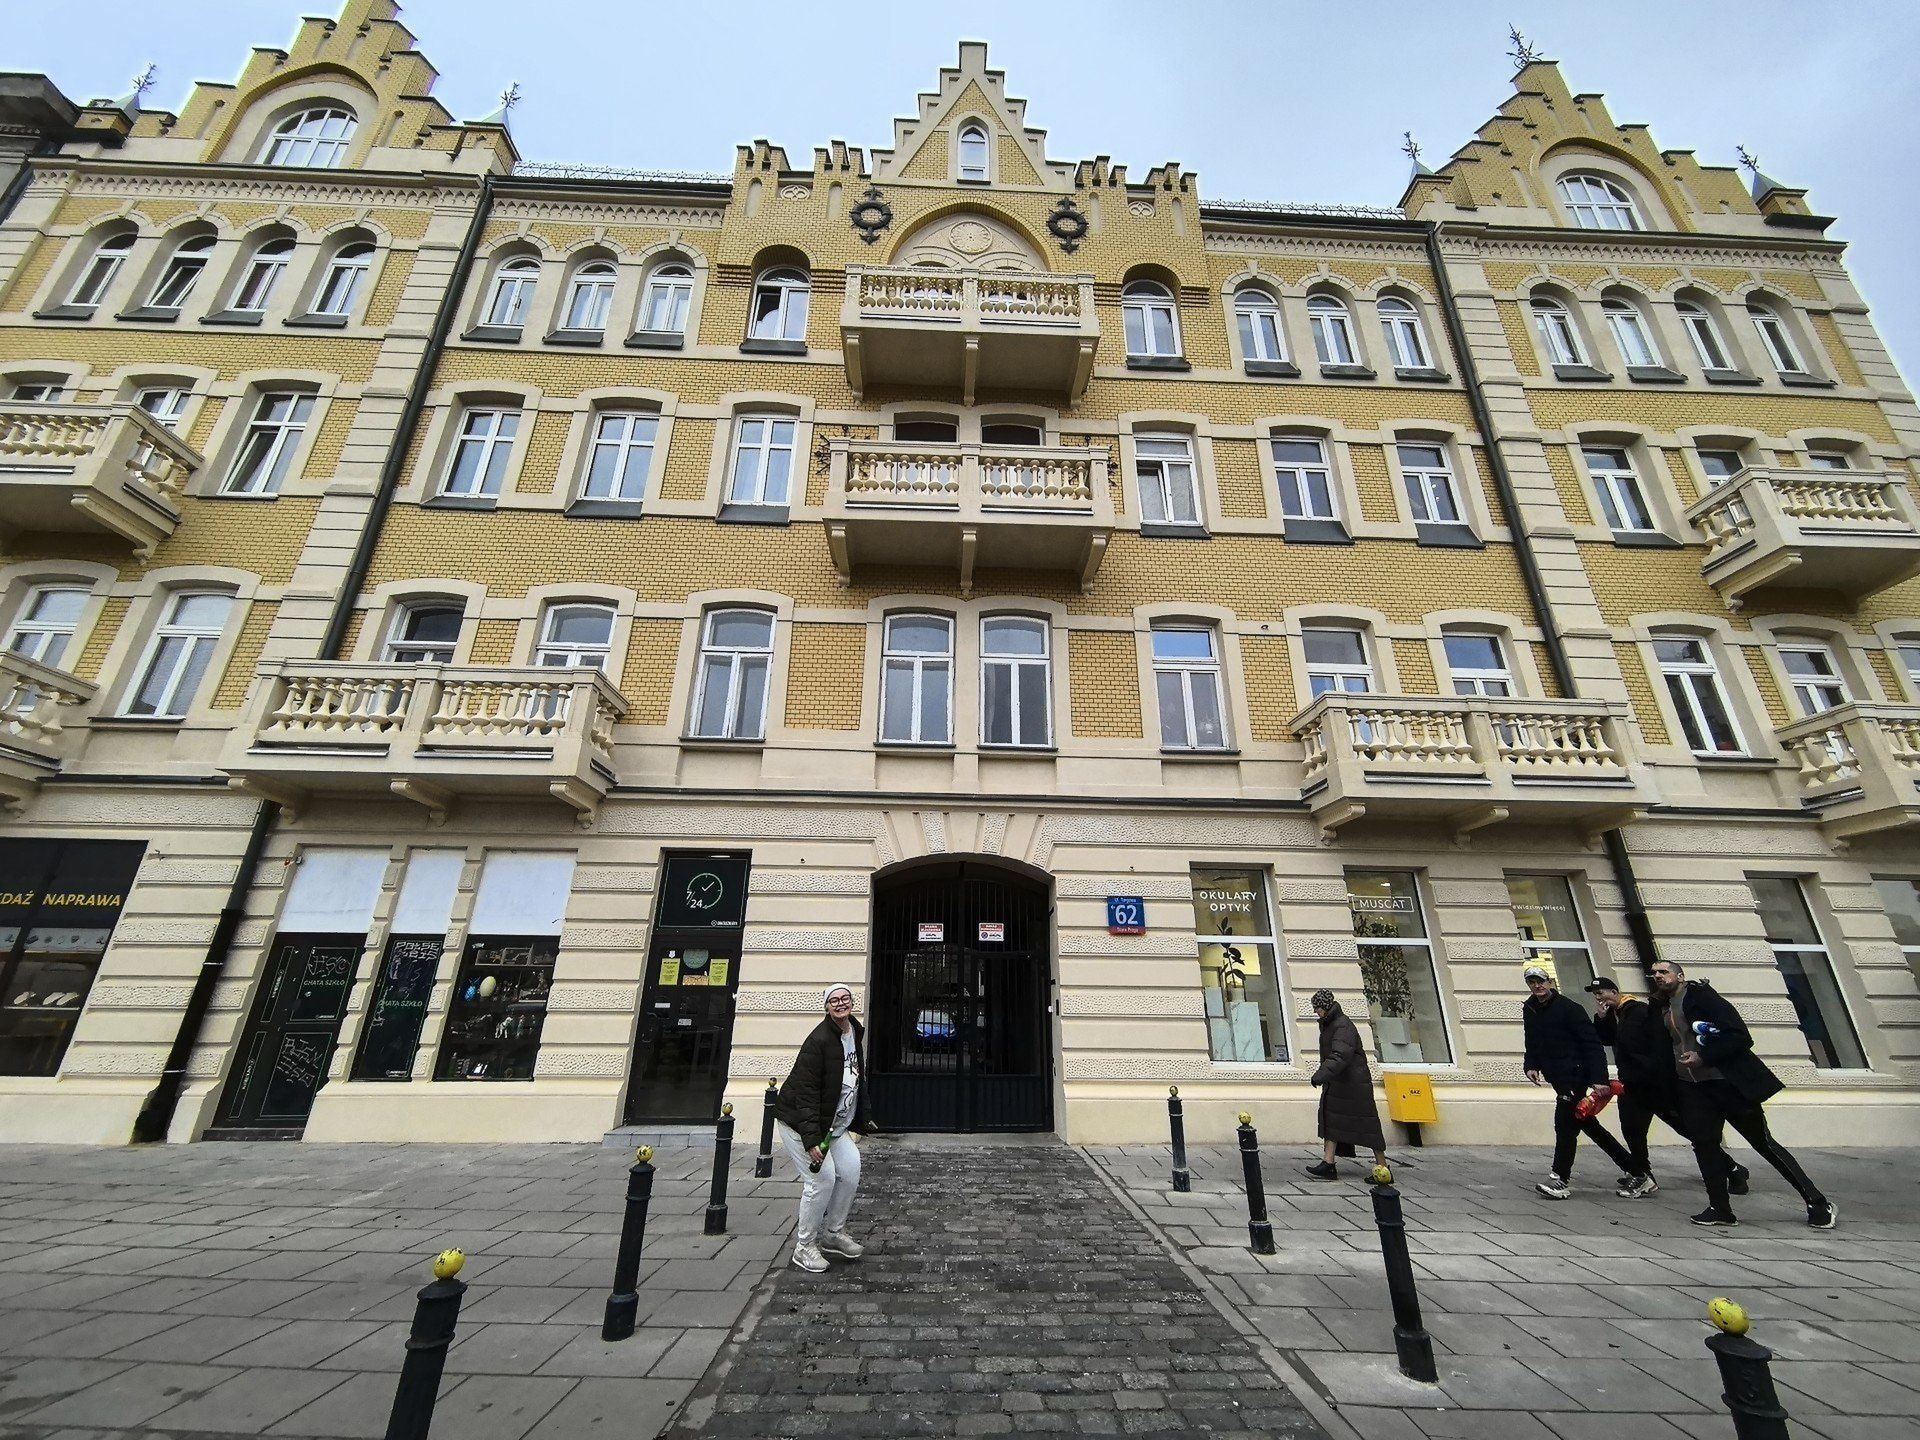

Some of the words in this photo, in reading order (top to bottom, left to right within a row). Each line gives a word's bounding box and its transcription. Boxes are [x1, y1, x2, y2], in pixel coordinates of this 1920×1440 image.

[42, 893, 121, 906] NAPRAWA
[1200, 891, 1257, 900] OKULARY
[1210, 903, 1250, 912] OPTYK
[1360, 899, 1405, 909] MUSCAT
[1115, 904, 1139, 925] 62
